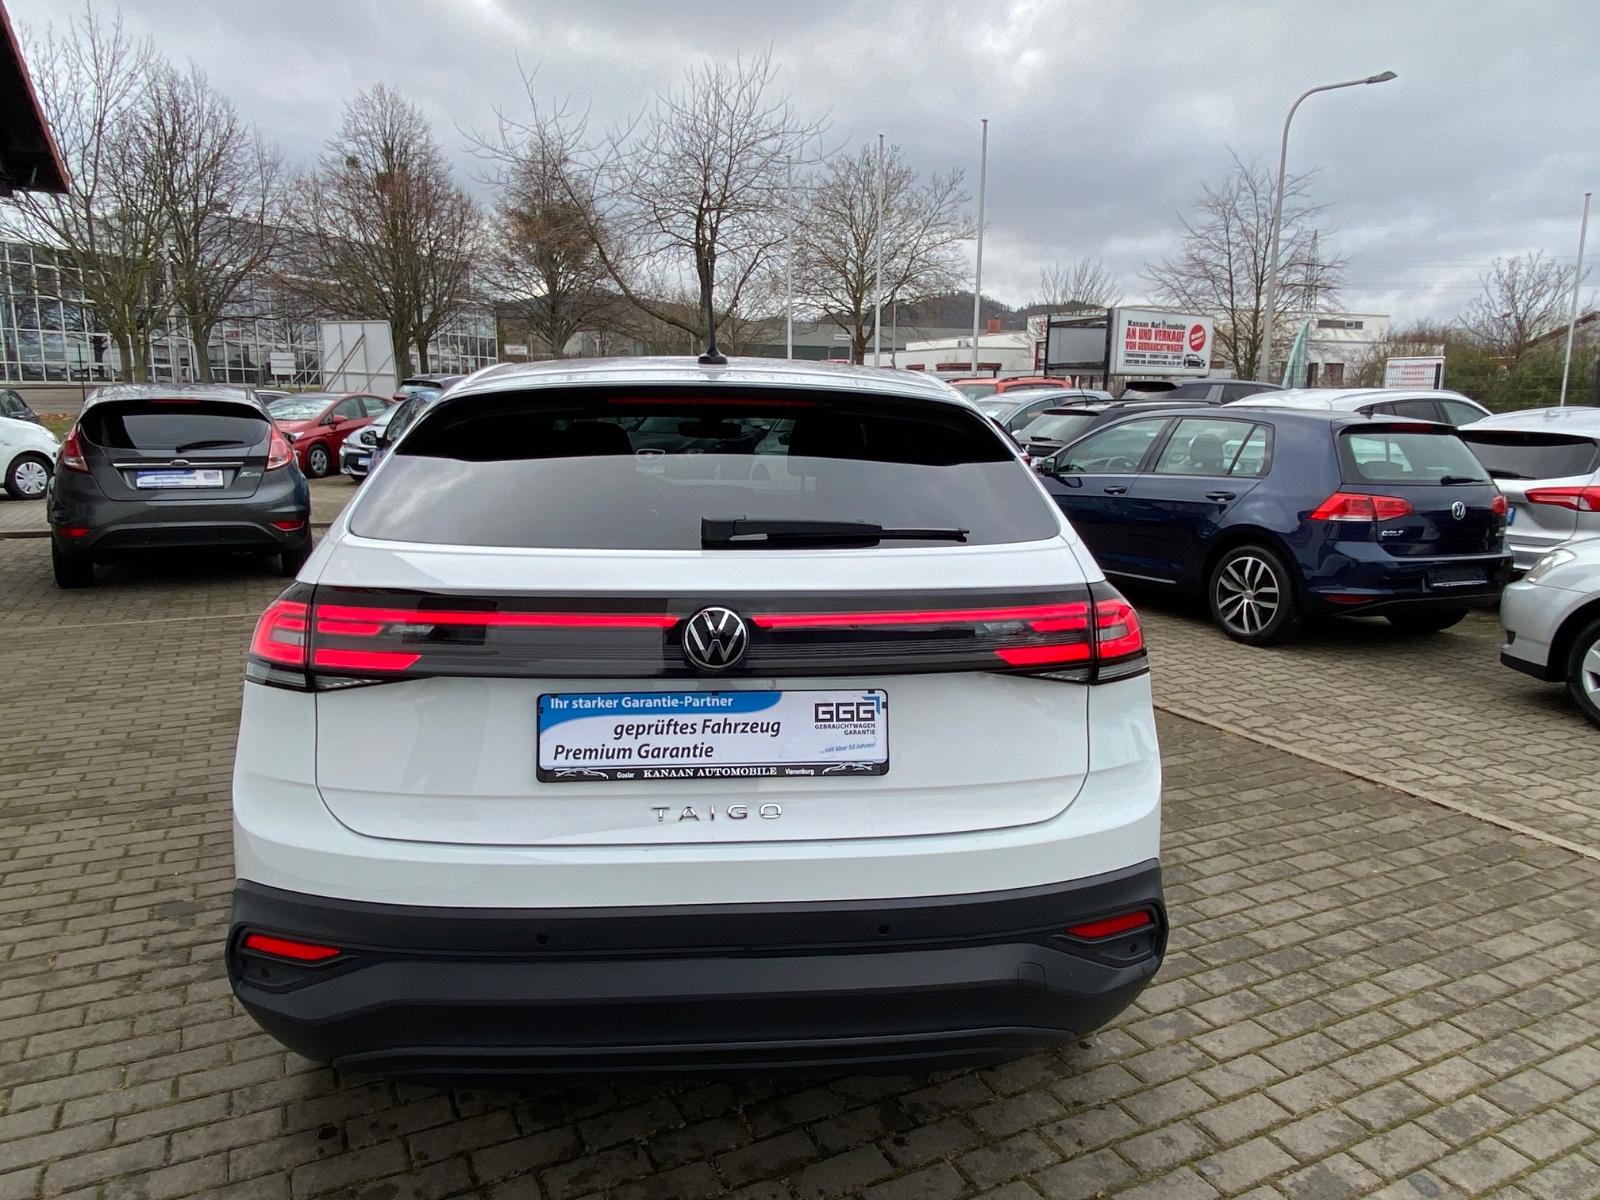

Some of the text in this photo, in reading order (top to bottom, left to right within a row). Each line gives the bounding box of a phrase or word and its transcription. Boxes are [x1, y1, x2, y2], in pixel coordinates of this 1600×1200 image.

[1126, 327, 1137, 339] AN
[1138, 328, 1153, 340] UND
[1154, 329, 1185, 342] VERKAUF
[550, 695, 734, 709] Ihr starker Garantie-Partner
[814, 702, 875, 722] GGG
[613, 718, 781, 740] geprüftes Fahrzeug
[814, 722, 876, 730] GEBRAUCHTWAGEN
[554, 743, 714, 761] Premium Garantie
[643, 768, 694, 778] KANAAN
[697, 767, 777, 777] AUTOMOBILE
[651, 803, 782, 823] TAIGO
